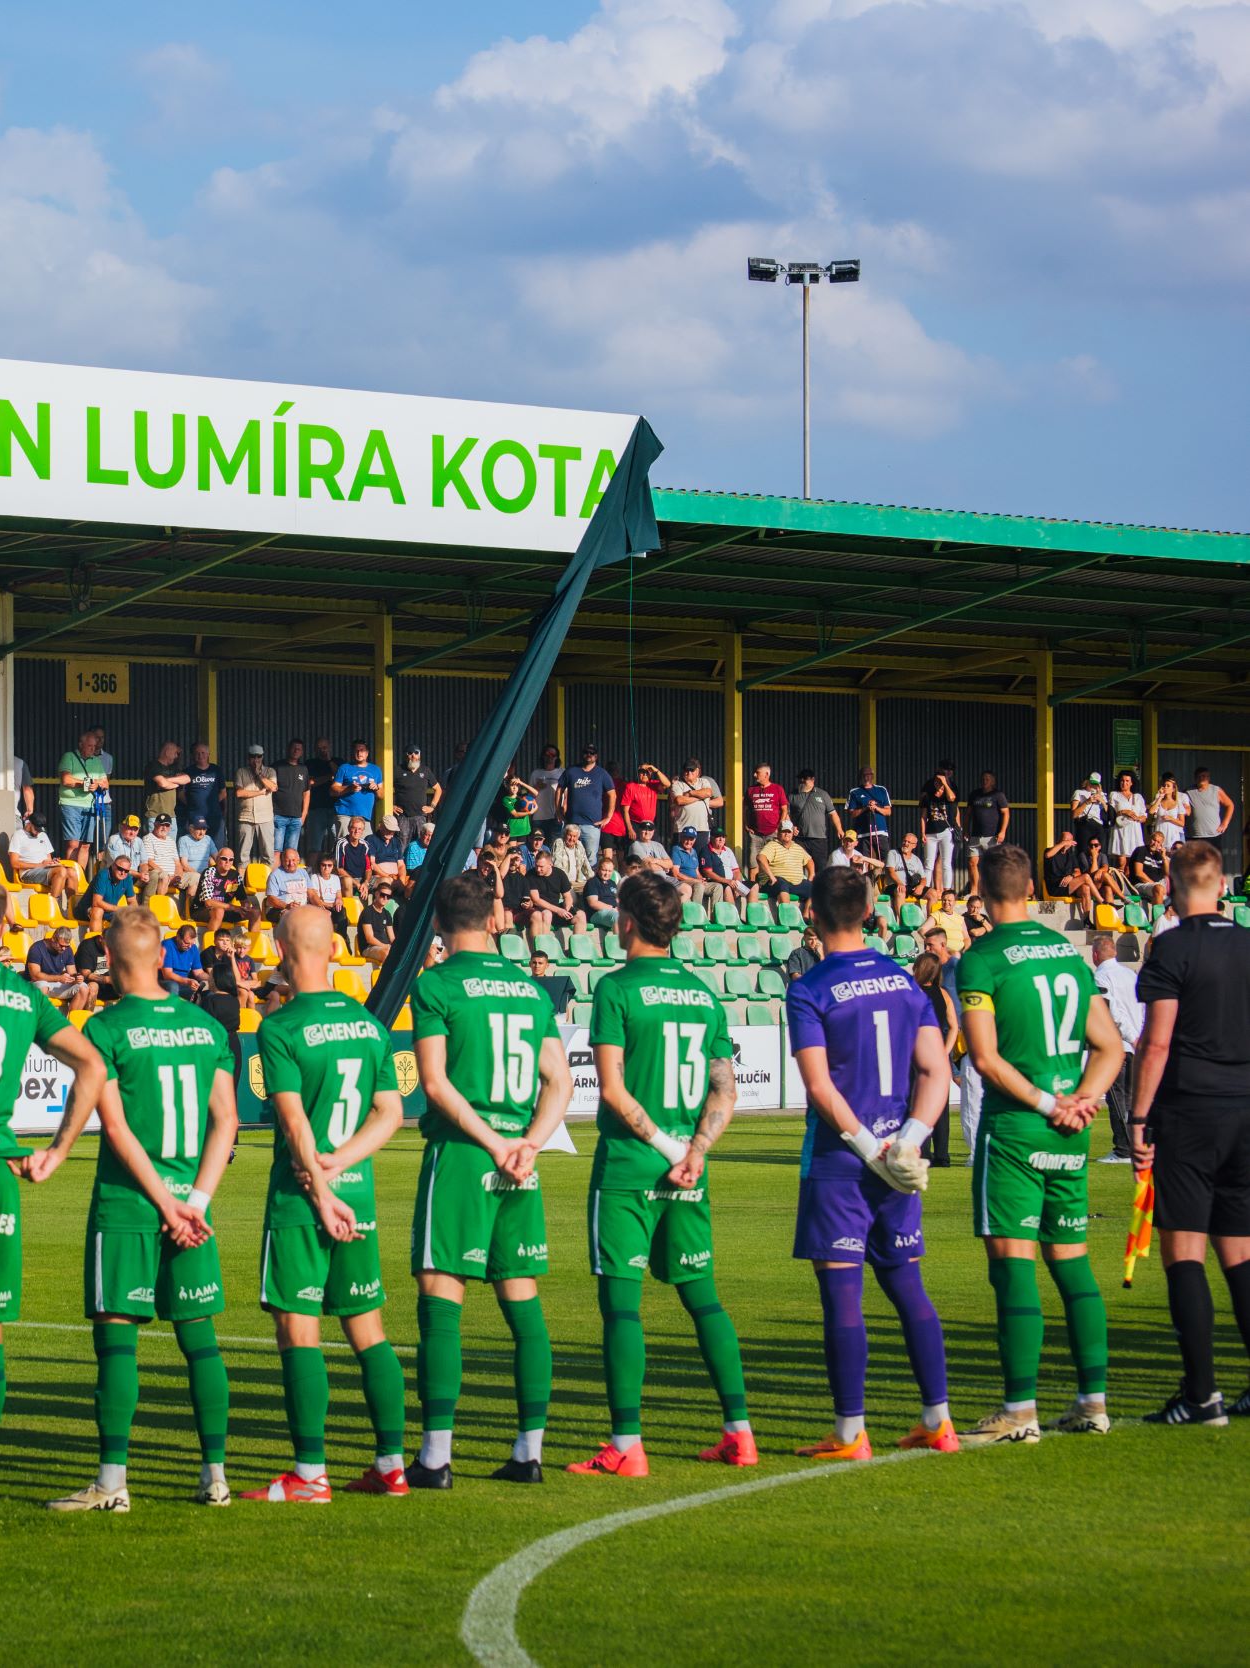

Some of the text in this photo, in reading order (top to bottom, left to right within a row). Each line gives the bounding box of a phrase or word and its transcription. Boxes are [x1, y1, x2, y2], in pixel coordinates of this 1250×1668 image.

[86, 401, 406, 506] LUMÍRA
[431, 433, 618, 519] KOTA
[76, 672, 117, 693] 1-366
[149, 1027, 215, 1047] GIENGER
[872, 1010, 893, 1097] 1
[1032, 973, 1081, 1057] 12
[16, 1078, 57, 1100] ex
[24, 1054, 58, 1073] ium
[488, 1013, 535, 1103] 15
[662, 1021, 707, 1110] 13
[733, 1070, 771, 1084] HLUČÍN
[158, 1064, 199, 1159] 11
[327, 1058, 363, 1148] 3
[189, 1282, 219, 1300] LAMA
